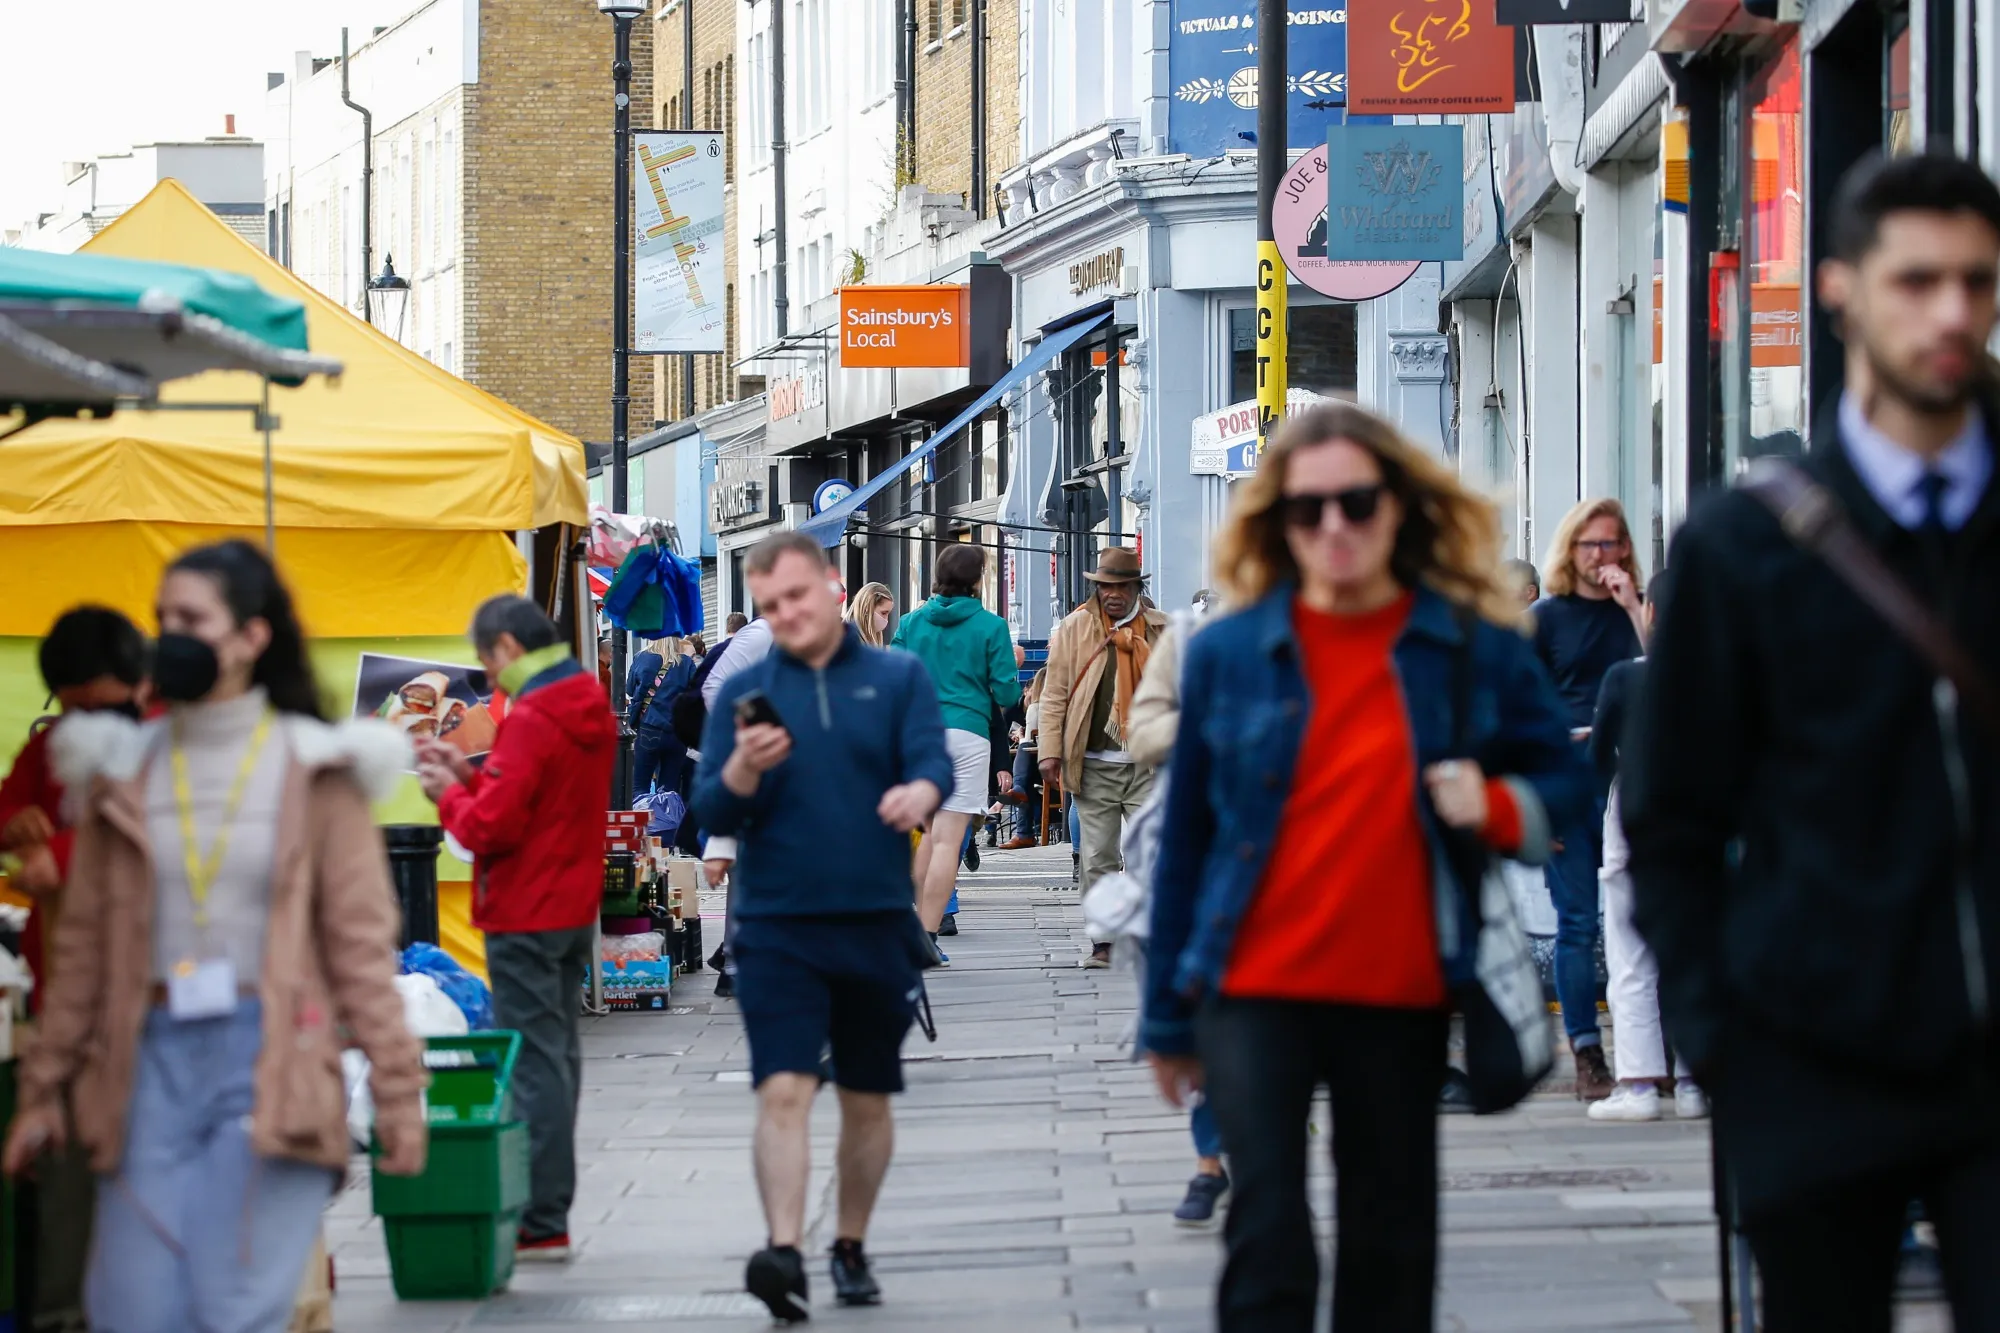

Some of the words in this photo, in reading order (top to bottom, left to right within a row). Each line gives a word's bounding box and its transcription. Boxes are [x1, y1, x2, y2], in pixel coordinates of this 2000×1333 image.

[1180, 15, 1239, 34] VICTUALS
[1242, 15, 1254, 28] &
[1400, 97, 1439, 105] ROASTED
[1284, 167, 1315, 204] JOE
[1313, 157, 1328, 173] &
[1338, 203, 1453, 230] Whittard
[682, 224, 717, 240] FLYOVER
[1298, 261, 1325, 269] COFFEE,
[1327, 260, 1347, 268] JUICE
[847, 308, 952, 329] Sainsbury's
[847, 329, 896, 347] Local
[1257, 259, 1272, 437] CCTV
[604, 991, 637, 999] Bartlett
